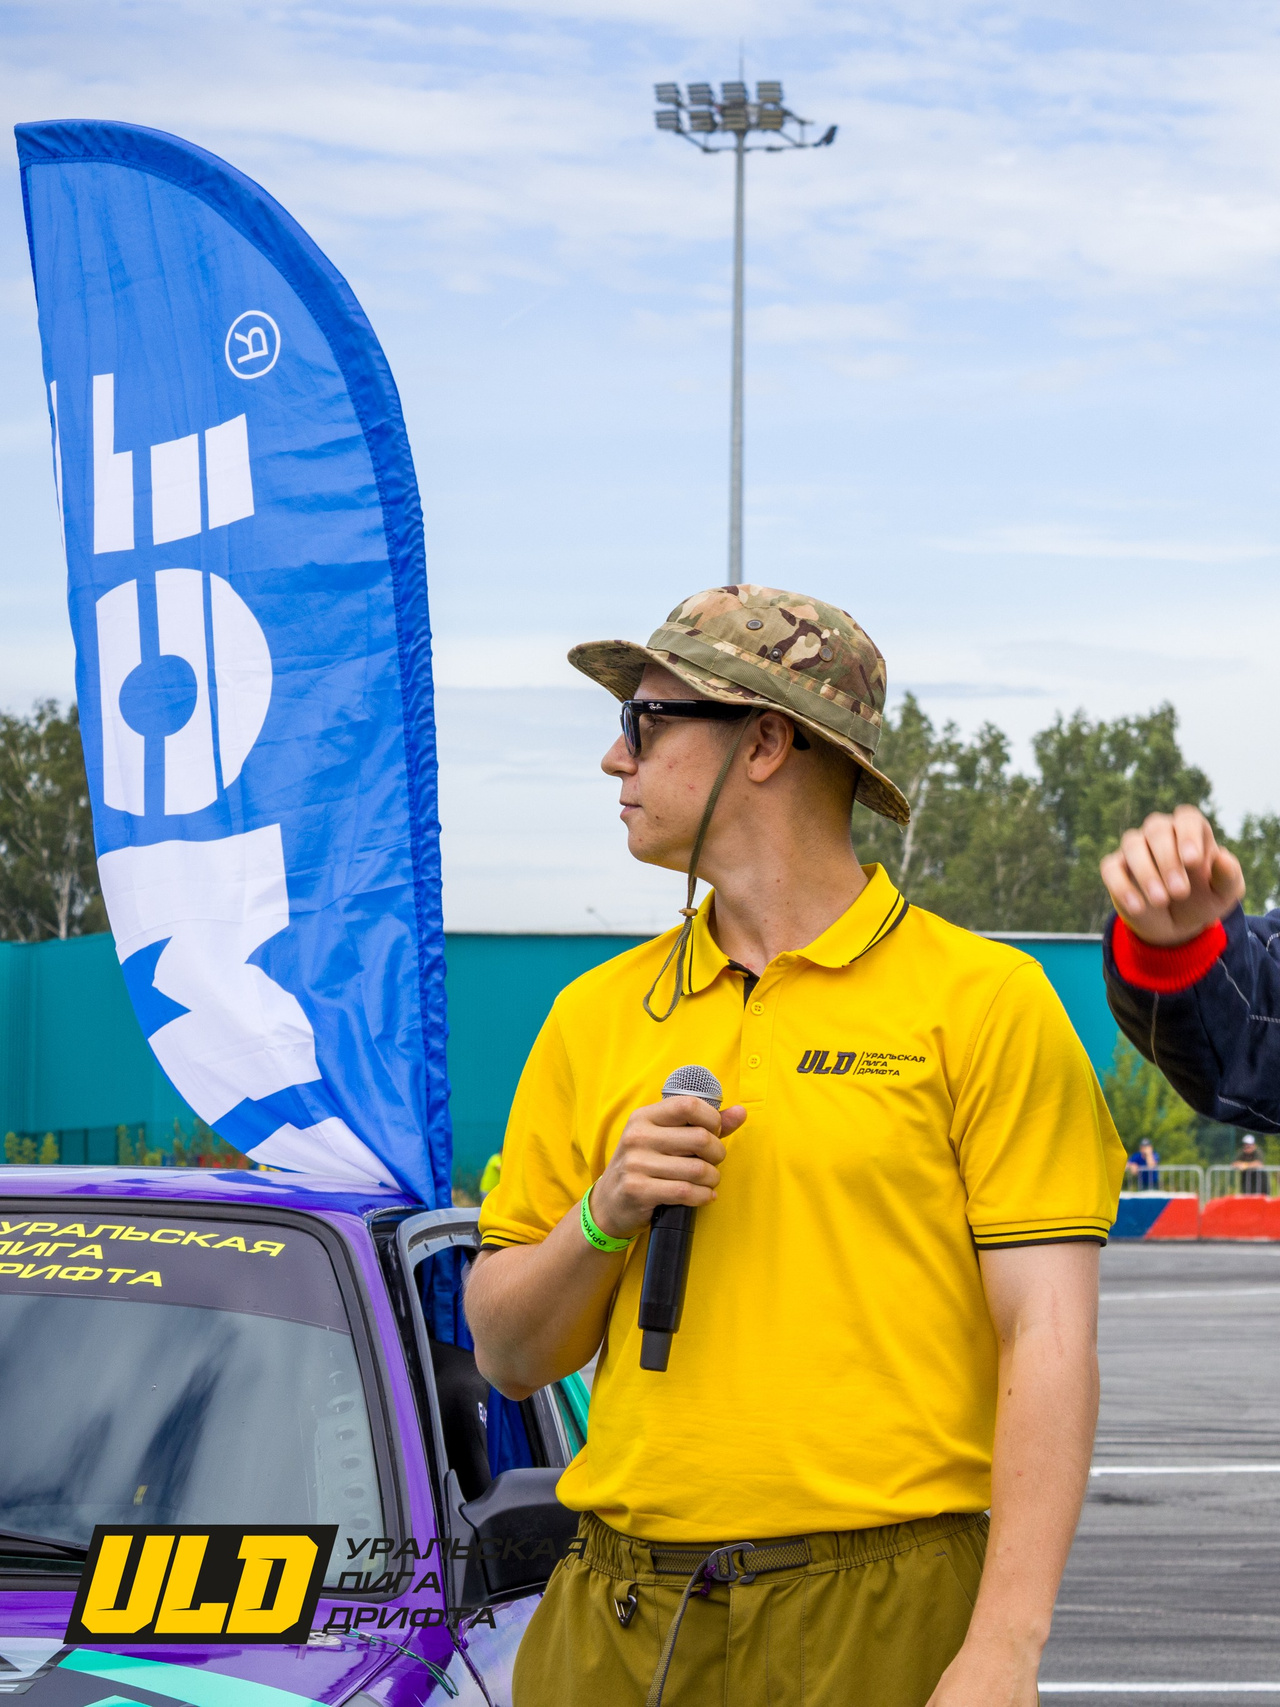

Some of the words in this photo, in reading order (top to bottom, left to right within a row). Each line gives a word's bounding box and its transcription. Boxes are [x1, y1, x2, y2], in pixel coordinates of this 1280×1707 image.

[796, 1050, 857, 1075] ULD
[865, 1052, 927, 1063] УРАЛЬСКАЯ
[857, 1068, 900, 1076] ДРИФТА
[0, 1221, 286, 1257] УРАЛЬСКАЯ
